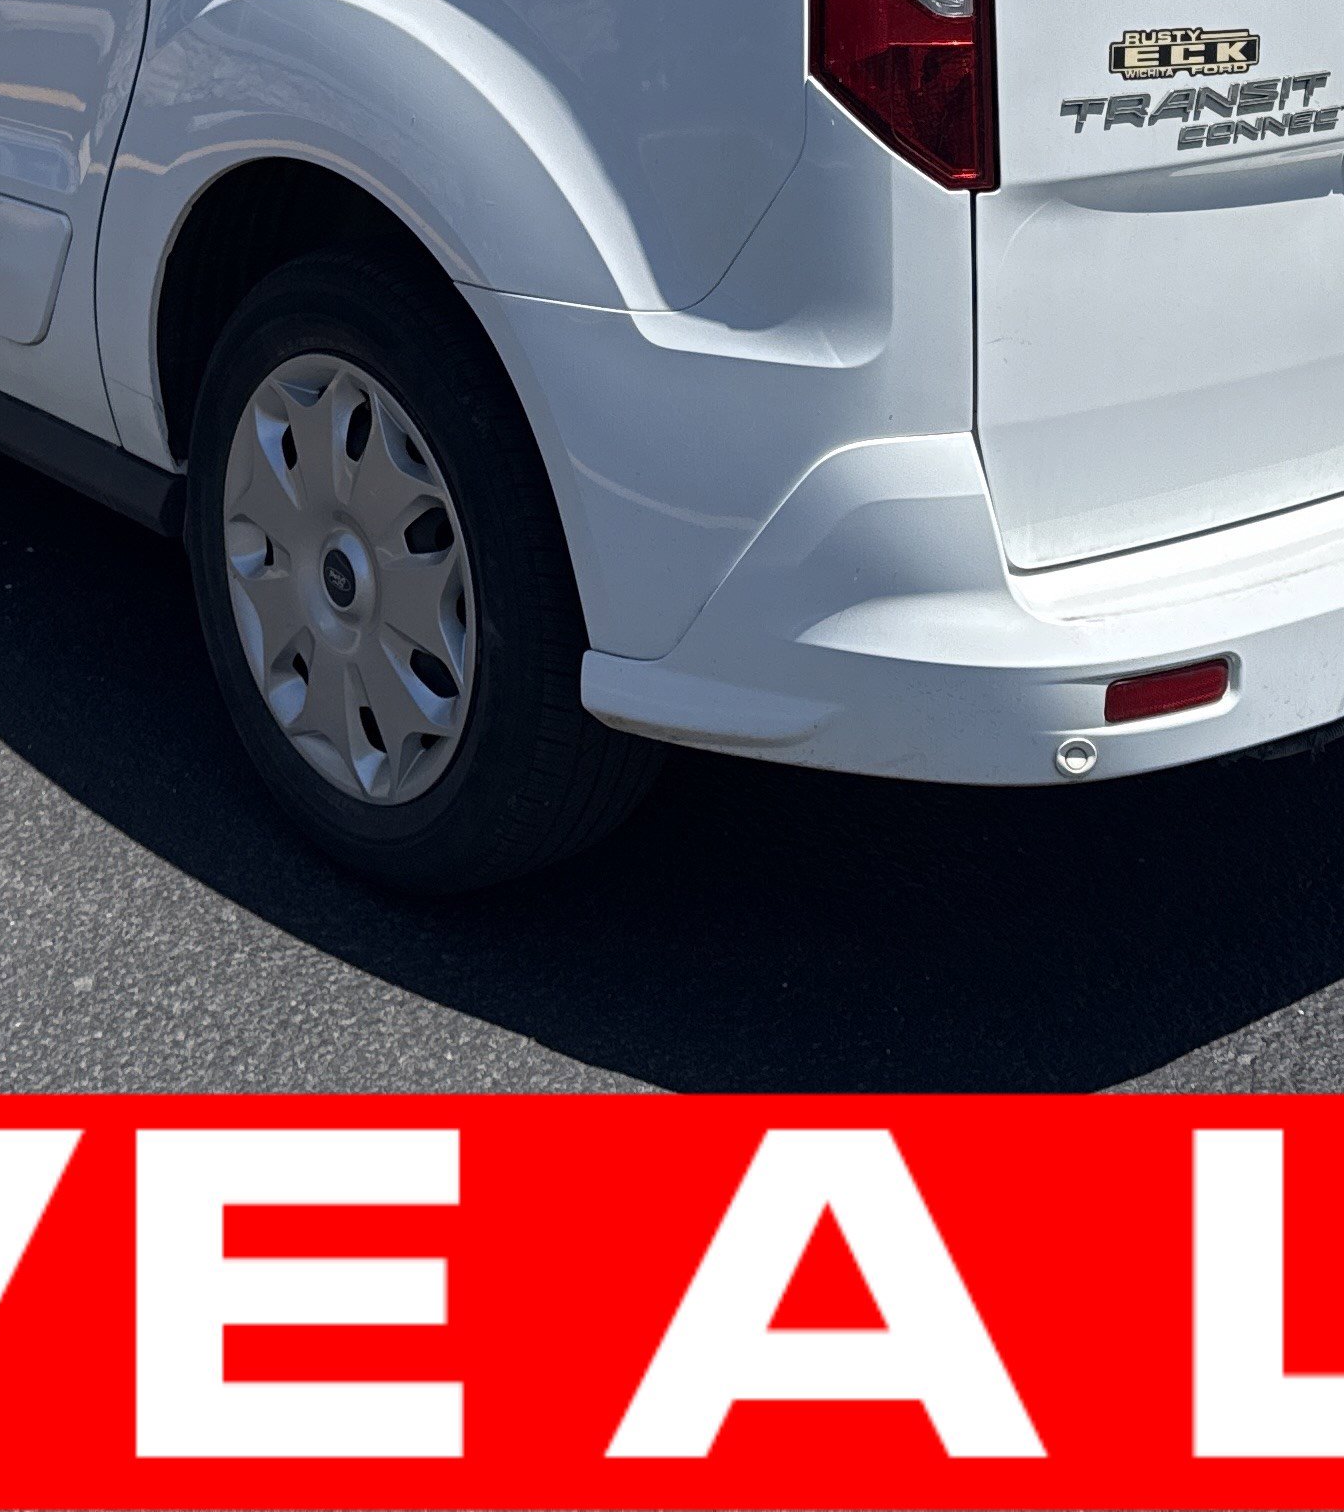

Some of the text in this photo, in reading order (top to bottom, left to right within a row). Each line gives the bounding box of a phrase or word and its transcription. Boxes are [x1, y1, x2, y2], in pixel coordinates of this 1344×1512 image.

[1124, 29, 1202, 46] RUSTY
[1123, 41, 1248, 68] ECK
[1124, 63, 1249, 80] WICHITA FORD
[1060, 70, 1332, 134] TRANSIT
